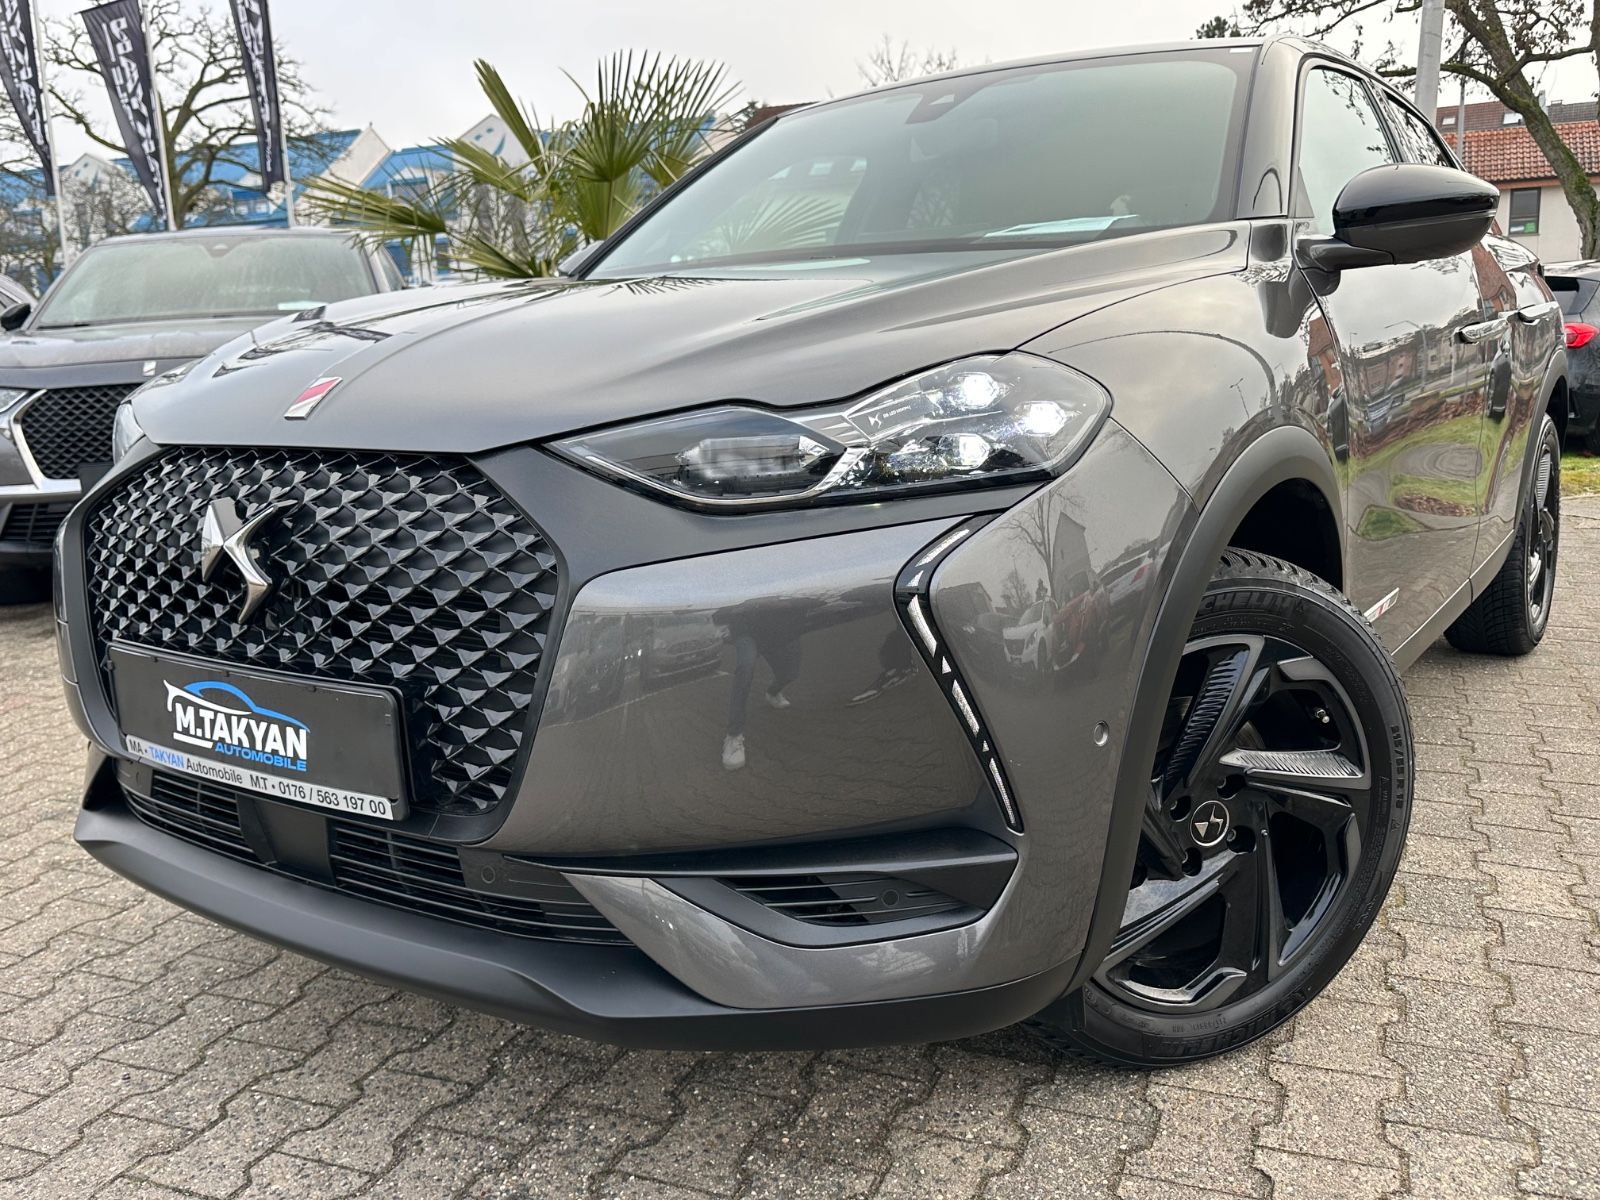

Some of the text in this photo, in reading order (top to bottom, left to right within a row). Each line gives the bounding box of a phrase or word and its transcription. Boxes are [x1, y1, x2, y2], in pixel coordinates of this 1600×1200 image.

[174, 702, 308, 761] M.TAKYAN
[214, 742, 308, 772] AUTOMOBILE
[129, 739, 144, 755] MA
[149, 746, 185, 769] TAKYAN
[186, 758, 243, 784] Automobile
[278, 781, 306, 799] 0176
[316, 790, 340, 806] 563
[343, 795, 365, 811] 197
[369, 799, 386, 815] 00
